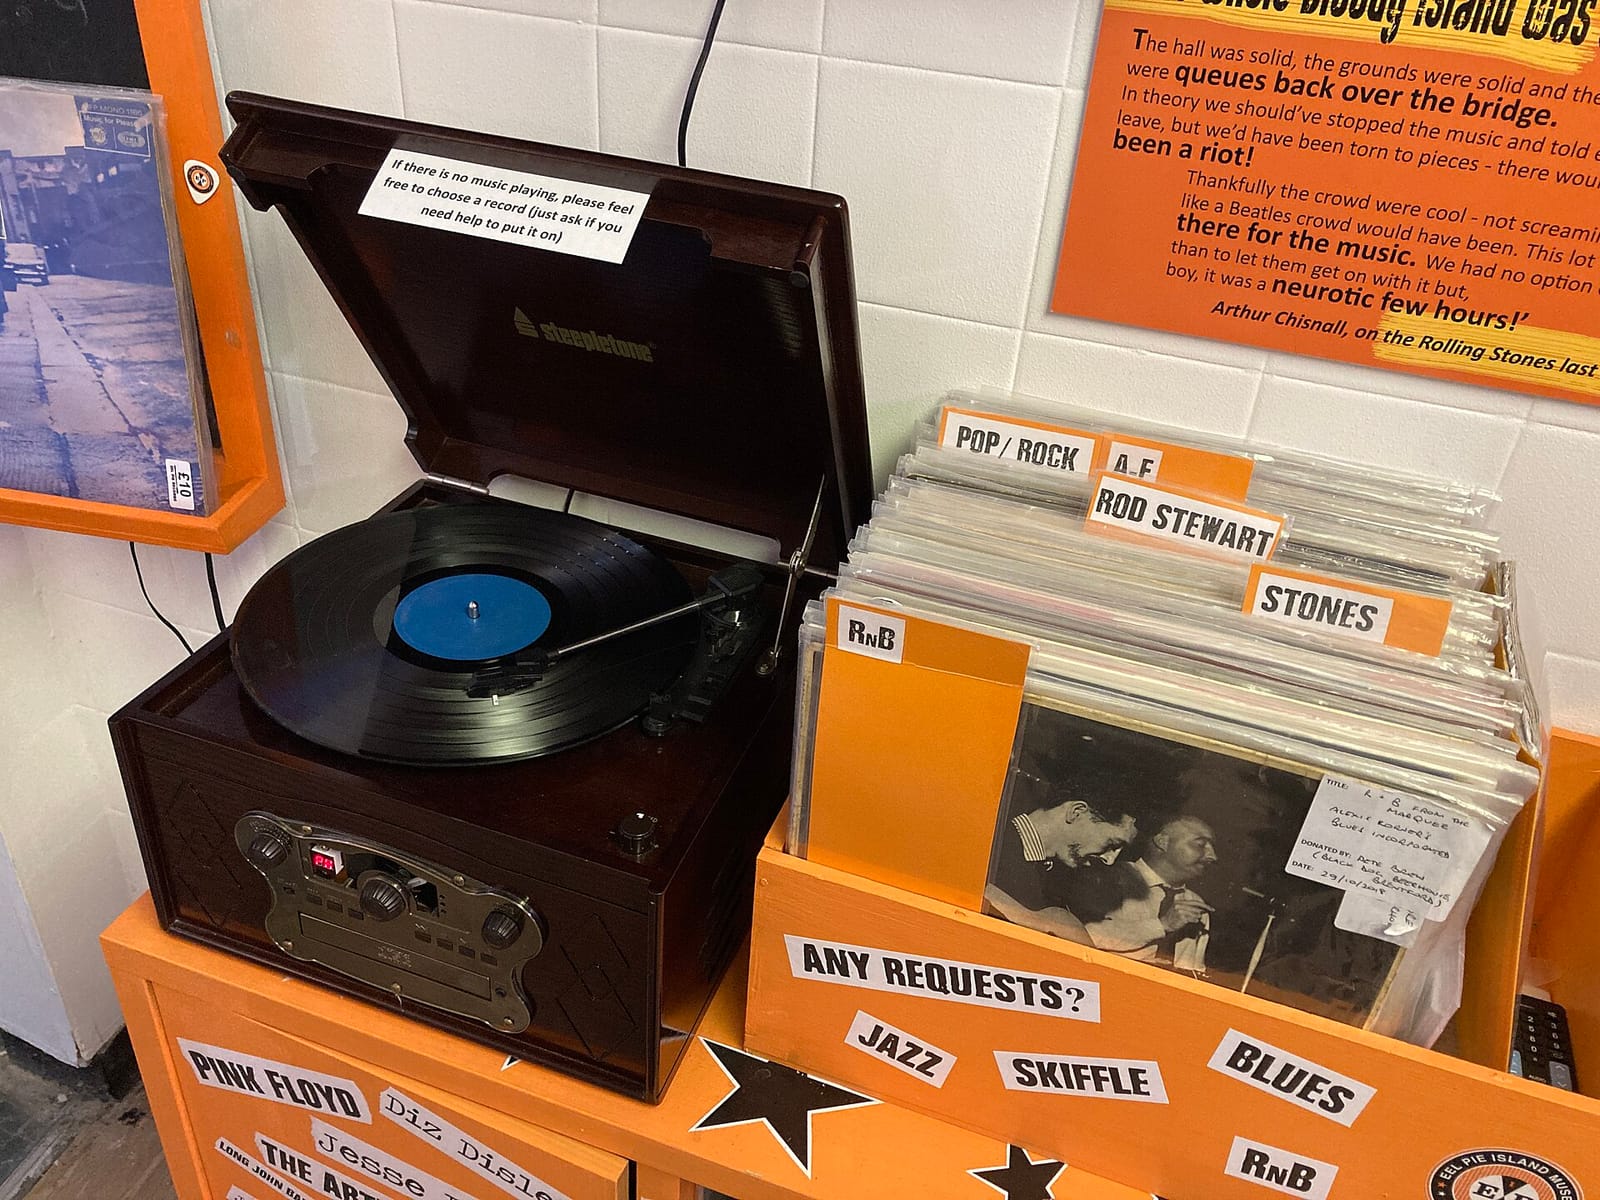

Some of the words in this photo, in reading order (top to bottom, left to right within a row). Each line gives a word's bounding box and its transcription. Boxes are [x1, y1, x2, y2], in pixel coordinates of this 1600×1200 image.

[1133, 28, 1168, 52] The
[1173, 38, 1205, 57] hall
[1210, 45, 1244, 62] was
[1249, 48, 1297, 71] solid,
[1304, 53, 1335, 72] the
[1339, 61, 1418, 82] grounds
[1424, 70, 1472, 88] were
[1477, 75, 1525, 95] solid
[1529, 83, 1568, 100] and
[1122, 86, 1138, 102] In
[1143, 88, 1200, 110] theory
[1205, 98, 1230, 112] we
[1326, 113, 1404, 135] stopped
[1409, 121, 1441, 139] the
[1445, 128, 1504, 148] music
[1507, 136, 1547, 153] and
[1550, 140, 1591, 160] told
[1127, 63, 1169, 80] were
[1175, 64, 1266, 91] queues
[1274, 70, 1336, 99] back
[1341, 83, 1403, 107] over
[1410, 88, 1455, 114] the
[1462, 92, 1558, 129] bridge.
[1113, 128, 1172, 156] been
[1178, 142, 1193, 159] a
[1200, 142, 1254, 167] riot!
[1117, 109, 1166, 132] leave,
[1171, 116, 1201, 135] but
[1206, 124, 1247, 141] we'd
[1251, 130, 1293, 148] have
[1299, 132, 1344, 154] been
[1350, 140, 1388, 160] torn
[1394, 148, 1414, 163] to
[1418, 150, 1479, 171] pieces
[1497, 160, 1549, 181] there
[1555, 171, 1600, 190] wou
[383, 176, 409, 190] free
[411, 183, 425, 194] to
[426, 186, 470, 204] choose
[473, 196, 482, 206] a
[484, 198, 527, 214] record
[528, 204, 558, 222] (just
[560, 211, 583, 226] ask
[585, 216, 598, 229] if
[596, 221, 622, 234] you
[391, 159, 403, 170] If
[403, 162, 437, 177] there
[439, 168, 450, 180] is
[452, 172, 468, 184] no
[471, 174, 508, 192] music
[509, 183, 559, 203] playing,
[561, 192, 605, 210] please
[607, 200, 634, 215] feel
[1187, 170, 1276, 199] Thankfully
[1280, 184, 1310, 201] the
[1314, 190, 1371, 210] crowd
[1376, 200, 1422, 216] were
[1426, 207, 1467, 224] cool
[1483, 214, 1517, 230] not
[1520, 220, 1600, 244] screami
[420, 205, 451, 220] need
[454, 212, 483, 228] help
[485, 218, 500, 230] to
[500, 222, 525, 236] put
[527, 226, 538, 238] it
[540, 229, 563, 244] on)
[1181, 193, 1209, 211] like
[1214, 201, 1223, 213] a
[1229, 202, 1292, 224] Beatles
[1296, 213, 1352, 233] crowd
[1356, 221, 1414, 241] would
[1417, 227, 1462, 248] have
[1466, 234, 1518, 257] been.
[1527, 244, 1564, 264] This
[1568, 250, 1596, 268] lot
[1171, 240, 1208, 259] than
[1213, 246, 1231, 262] to
[1235, 249, 1258, 266] let
[1262, 255, 1307, 274] them
[1311, 265, 1341, 280] get
[1344, 270, 1367, 284] on
[1372, 273, 1412, 291] with
[1416, 278, 1431, 293] it
[1433, 280, 1470, 302] but,
[1177, 213, 1240, 239] there
[1247, 222, 1283, 245] for
[1289, 230, 1329, 253] the
[1336, 243, 1416, 267] music.
[1426, 254, 1456, 272] We
[1460, 258, 1498, 278] had
[1500, 268, 1526, 283] no
[1530, 273, 1594, 294] option
[1166, 261, 1199, 282] boy,
[1204, 268, 1216, 282] it
[1221, 274, 1253, 290] was
[1257, 280, 1267, 291] a
[1271, 278, 1375, 308] neurotic
[1380, 291, 1428, 316] few
[539, 322, 653, 362] steepletone
[1211, 300, 1271, 322] Arthur
[1274, 312, 1349, 338] Chisnall,
[1354, 327, 1379, 340] on
[1382, 330, 1415, 347] the
[1418, 336, 1486, 362] Rolling
[1489, 346, 1557, 370] Stones
[1559, 357, 1599, 378] last
[1018, 438, 1080, 472] ROCK
[178, 472, 192, 498] £10
[1095, 488, 1148, 524] ROD
[1152, 505, 1275, 558] STEWART
[1260, 584, 1379, 632] STONES
[1326, 778, 1349, 790] TITLE:
[1331, 817, 1365, 834] BLUES
[1386, 807, 1450, 830] MARQUEE
[1292, 860, 1314, 872] DATE:
[1300, 838, 1342, 854] DONATED
[1339, 848, 1352, 858] BY:
[803, 943, 870, 980] ANY
[882, 956, 1086, 1012] REQUESTS?
[858, 1024, 944, 1078] JAZZ
[1012, 1058, 1151, 1096] SKIFFLE
[1225, 1041, 1355, 1114] BLUES
[188, 1050, 266, 1094] PINK
[264, 1070, 362, 1119] FLOYD
[385, 1093, 442, 1142] Diz
[220, 1140, 250, 1168] LONG
[252, 1166, 284, 1190] JOHN
[260, 1139, 312, 1184] THE
[318, 1132, 425, 1197] Jesse
[1440, 1164, 1463, 1180] EEL
[1461, 1154, 1488, 1166] PIE
[1491, 1154, 1550, 1174] ISLAND
